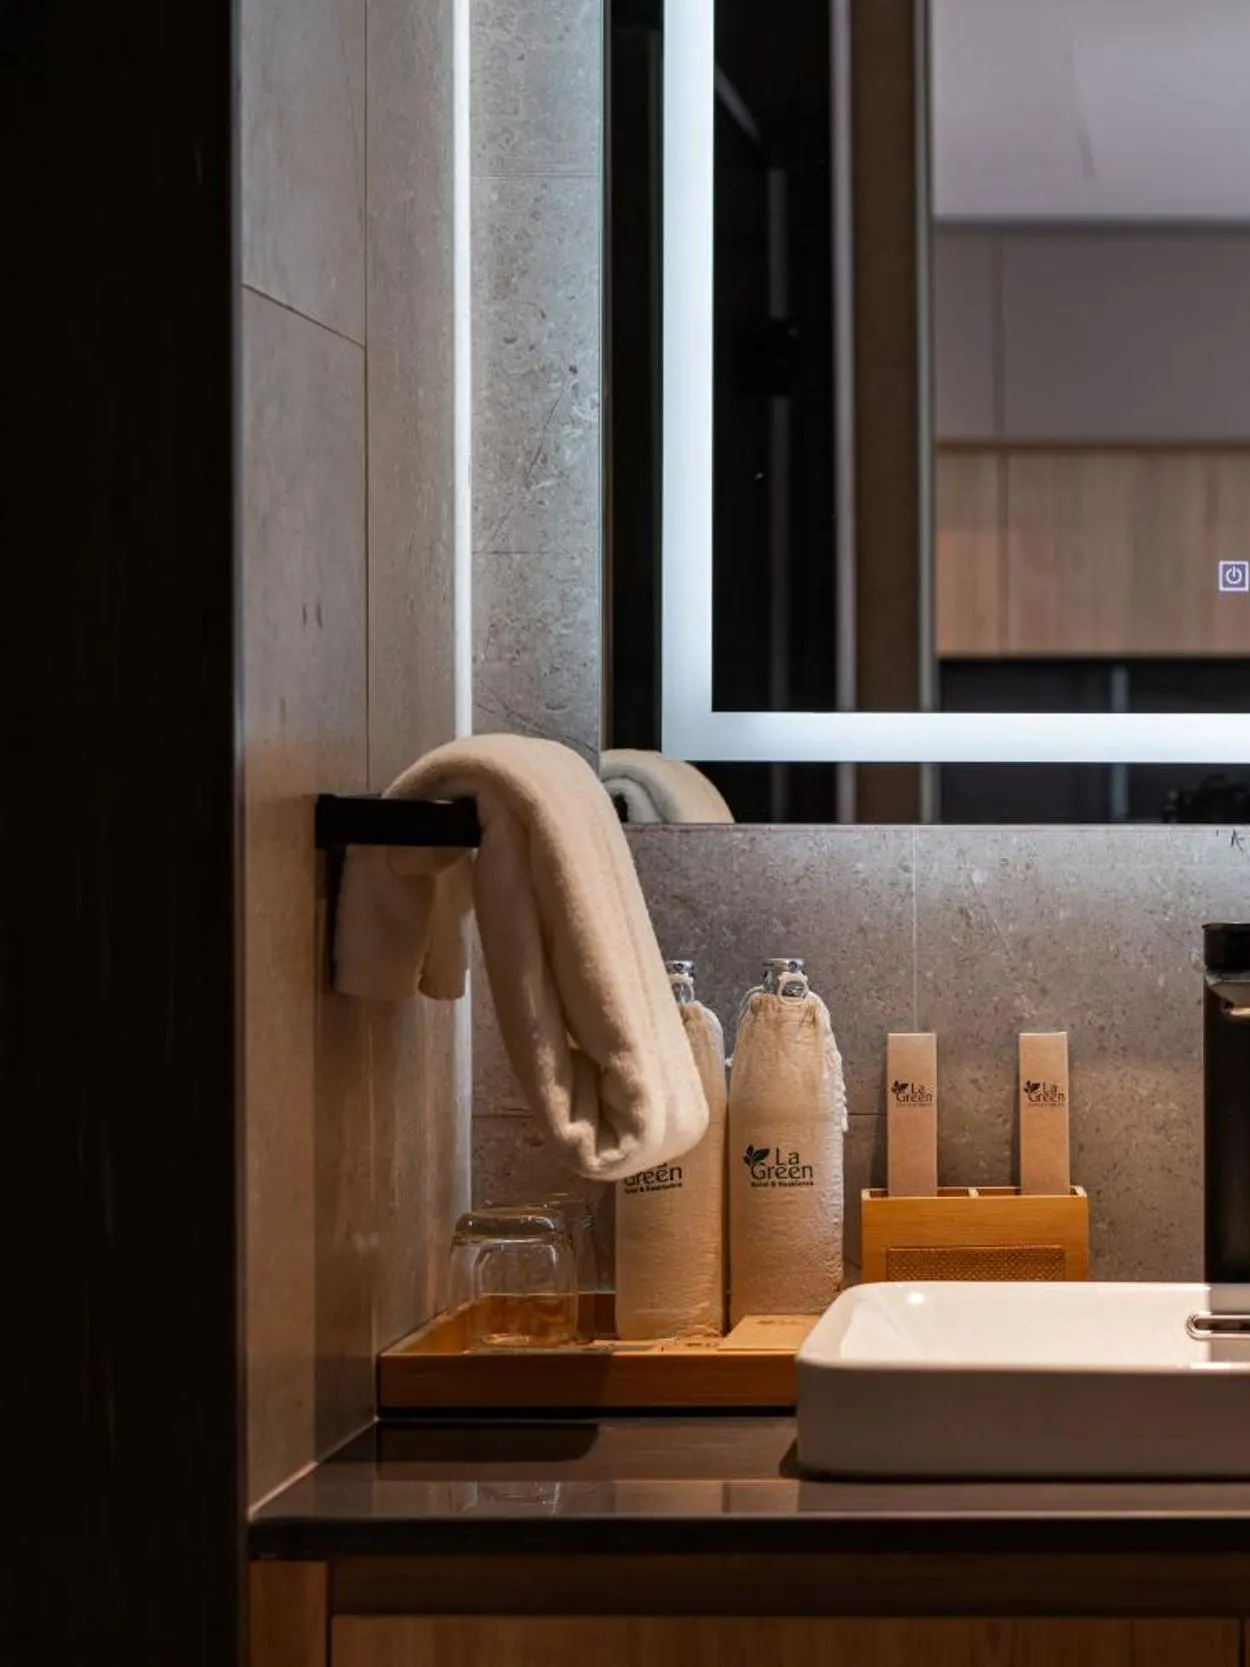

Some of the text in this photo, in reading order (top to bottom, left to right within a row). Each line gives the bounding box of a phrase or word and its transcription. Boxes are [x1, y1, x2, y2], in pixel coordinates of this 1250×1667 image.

[911, 1082, 925, 1094] La
[896, 1091, 933, 1103] Green
[1028, 1091, 1065, 1103] Green
[776, 1147, 800, 1166] La
[751, 1163, 813, 1180] Green
